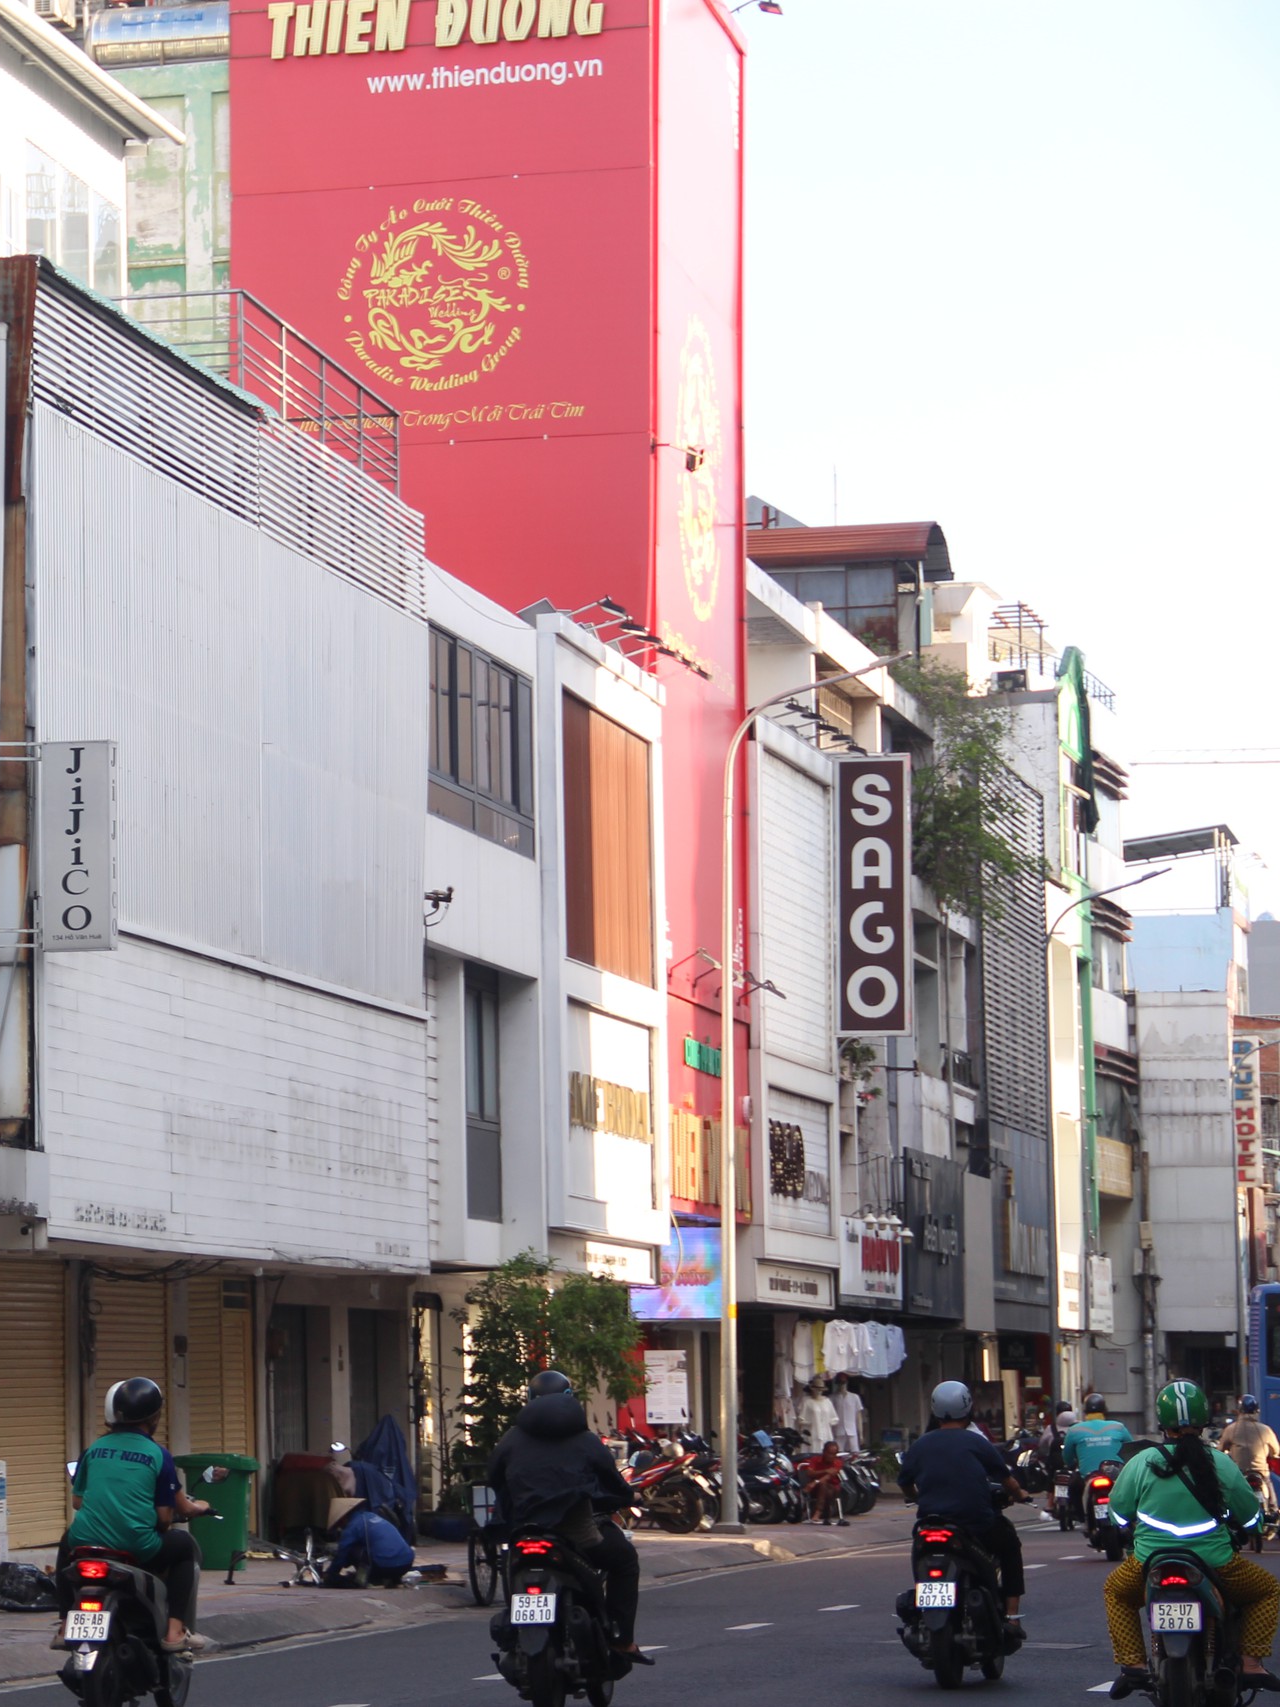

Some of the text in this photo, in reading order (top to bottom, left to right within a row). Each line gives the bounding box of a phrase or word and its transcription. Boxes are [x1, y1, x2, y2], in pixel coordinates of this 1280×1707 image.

[367, 58, 603, 94] www.thienduong.vn
[337, 257, 362, 301] Công
[355, 231, 378, 252] Ty
[458, 199, 504, 232] Thiên
[362, 284, 465, 309] PARADISE
[429, 303, 477, 322] Wedding
[345, 327, 521, 391] Paradise Wedding Group
[403, 409, 454, 432] Trong
[504, 403, 546, 421] Trái
[549, 401, 586, 419] Tim
[846, 773, 899, 1019] SAGO
[1233, 1040, 1256, 1183] BLUE HOTEL
[89, 1447, 153, 1466] VIET NAM
[922, 1583, 949, 1594] 29-Z1
[518, 1596, 549, 1608] 59-EA
[919, 1595, 952, 1606] 807.65
[1158, 1604, 1193, 1616] 52-U7
[73, 1613, 104, 1625] 86-AB
[514, 1609, 552, 1621] 068.10
[1159, 1617, 1194, 1629] 2876
[70, 1626, 105, 1639] 115.79
